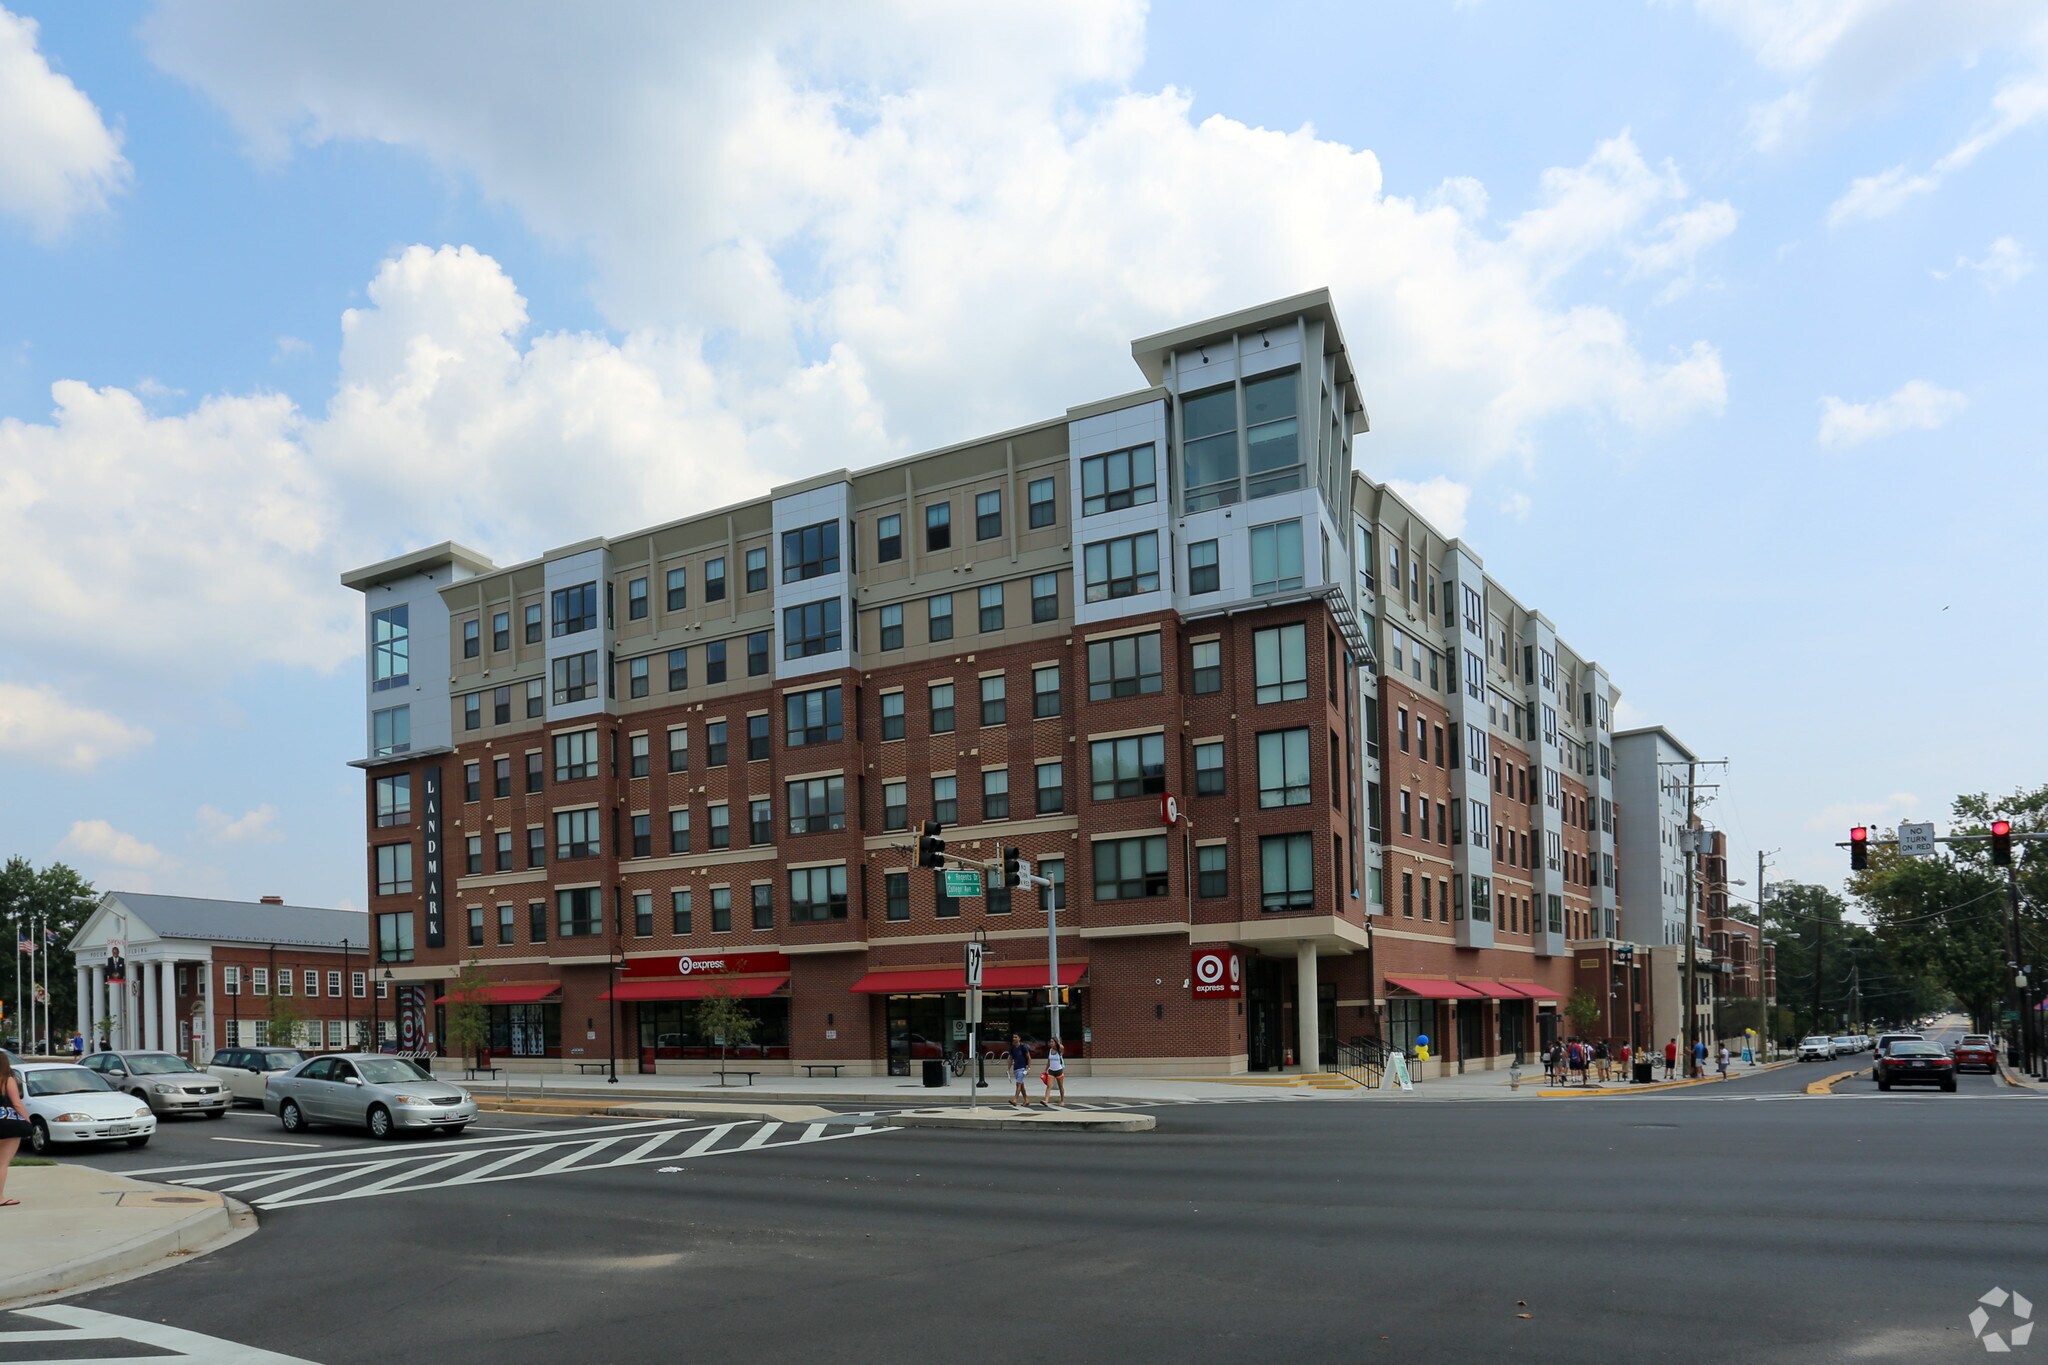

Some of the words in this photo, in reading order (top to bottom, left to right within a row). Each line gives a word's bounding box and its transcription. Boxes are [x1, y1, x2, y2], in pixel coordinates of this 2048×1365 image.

[1910, 827, 1923, 835] NO
[1901, 844, 1913, 852] ON
[427, 780, 438, 935] LANDMARK
[955, 873, 971, 883] Regents
[947, 885, 961, 894] College
[692, 960, 725, 971] express
[1196, 984, 1225, 993] express
